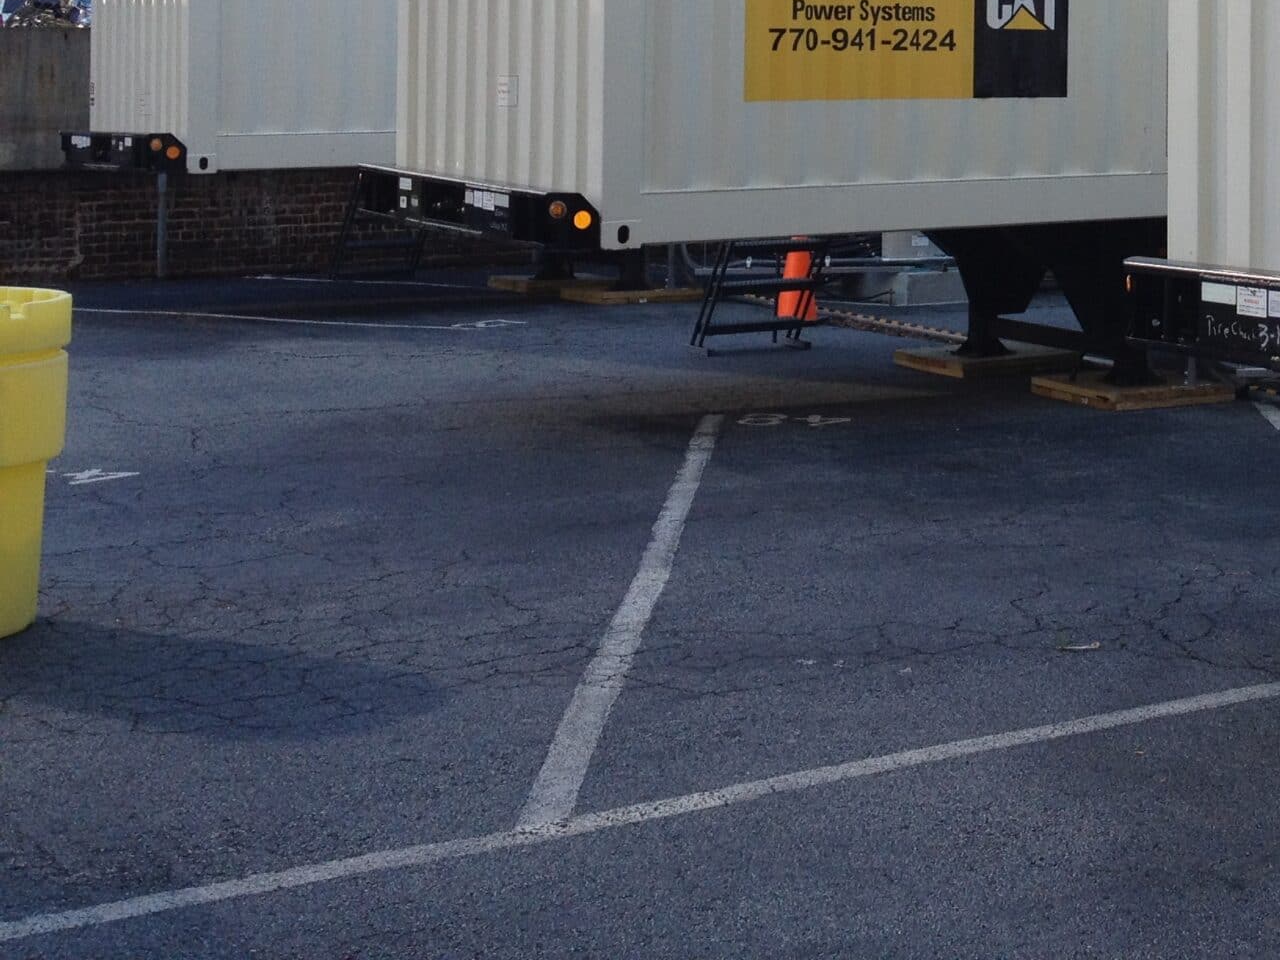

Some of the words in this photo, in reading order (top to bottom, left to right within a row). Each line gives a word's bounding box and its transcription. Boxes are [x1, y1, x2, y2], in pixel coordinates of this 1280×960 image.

[793, 0, 854, 21] Power
[860, 0, 935, 25] Systems
[769, 28, 956, 52] 770-941-2424
